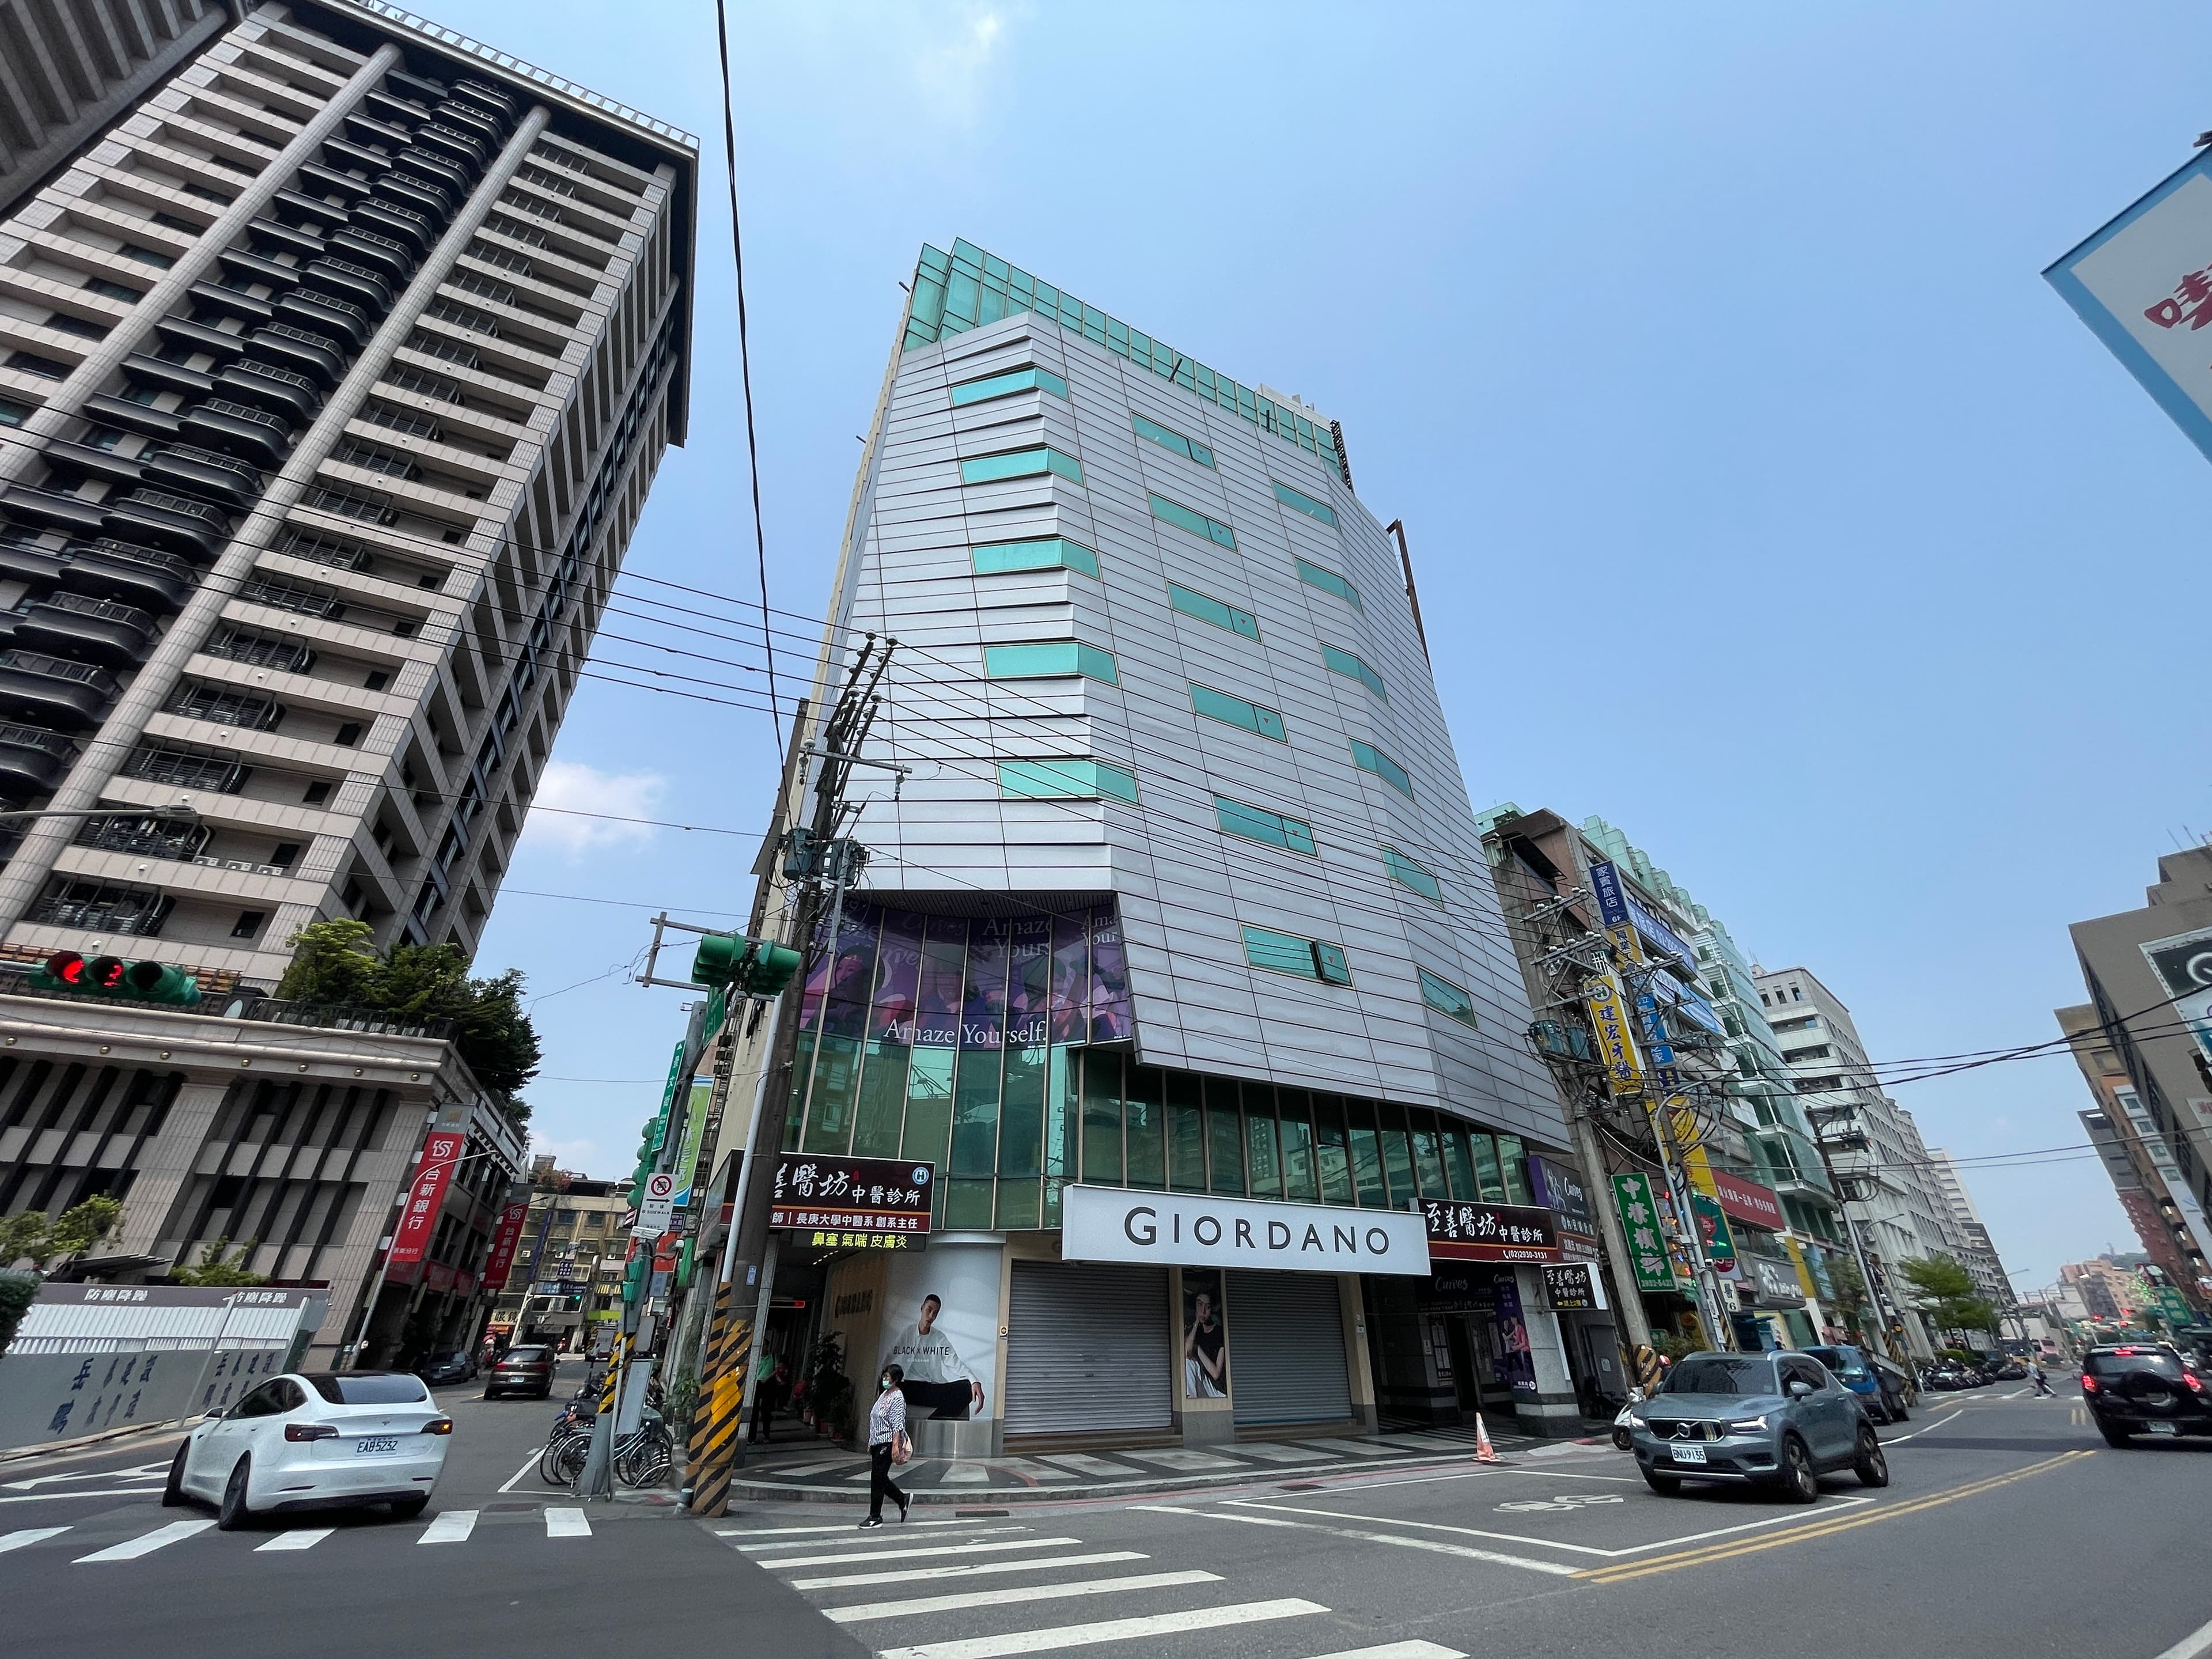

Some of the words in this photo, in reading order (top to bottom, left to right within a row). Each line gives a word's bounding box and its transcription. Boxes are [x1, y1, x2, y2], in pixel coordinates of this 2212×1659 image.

[882, 1018, 955, 1043] Amaze
[1598, 1005, 1631, 1080] 建宏牙醫
[408, 1168, 440, 1230] 台新銀行
[852, 1184, 921, 1206] 中醫診所
[796, 1213, 873, 1226] 長庚大學中醫系
[876, 1216, 918, 1229] 創系主任
[1124, 1206, 1390, 1256] GIORDANO
[1426, 1202, 1496, 1238] 至善醫坊
[1499, 1225, 1543, 1244] 中醫診所
[495, 1226, 516, 1268] 台新銀行
[812, 1231, 838, 1246] 鼻塞
[841, 1233, 867, 1248] 氣喘
[870, 1234, 907, 1248] 皮膚炎
[1546, 1269, 1586, 1286] 至善醫坊
[1555, 1287, 1585, 1298] 中醫診所
[893, 1346, 916, 1355] BLACK
[922, 1346, 950, 1355] WHITE
